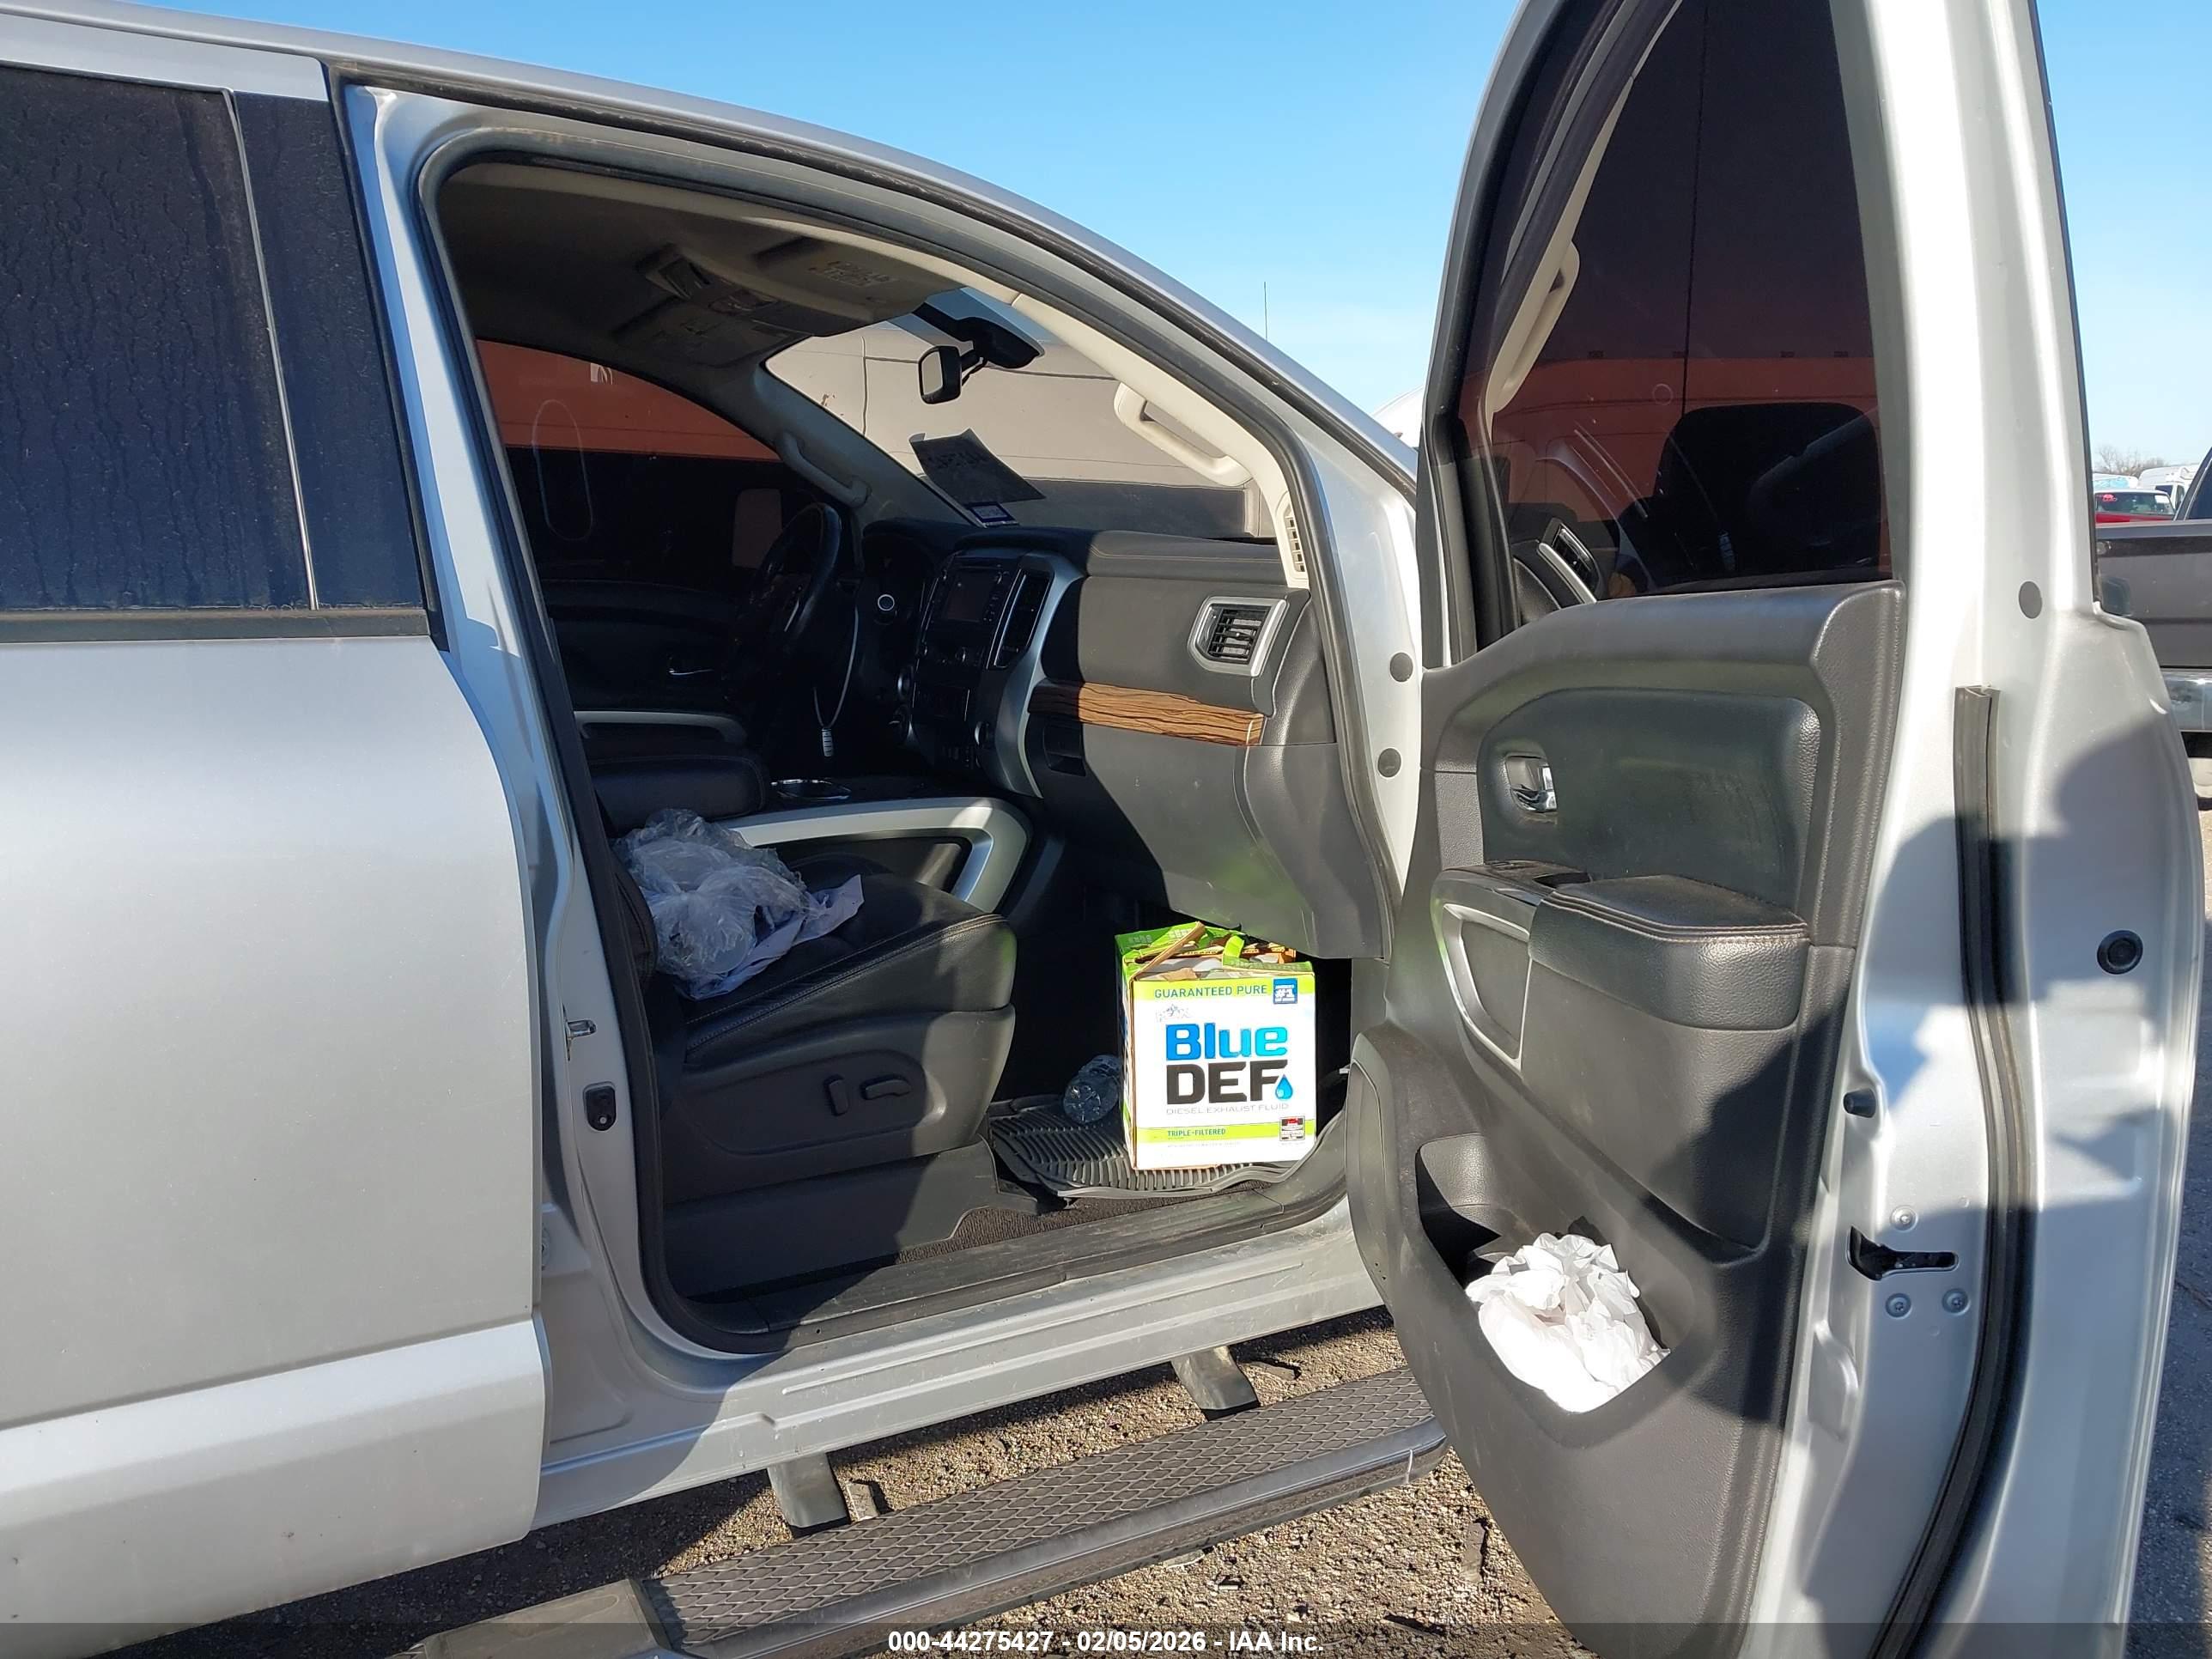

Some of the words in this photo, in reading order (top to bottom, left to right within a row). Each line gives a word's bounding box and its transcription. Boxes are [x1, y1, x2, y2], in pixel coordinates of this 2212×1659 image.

[1154, 986, 1233, 999] GUARANTEED
[1237, 984, 1267, 994] PURE
[1165, 1022, 1288, 1061] Blue
[1165, 1060, 1288, 1105] DEF
[1166, 1107, 1203, 1115] DIESEL
[1206, 1104, 1255, 1114] EXHAUST
[1258, 1103, 1289, 1111] FLUID
[1167, 1127, 1226, 1137] TRIPLE-FILTERED
